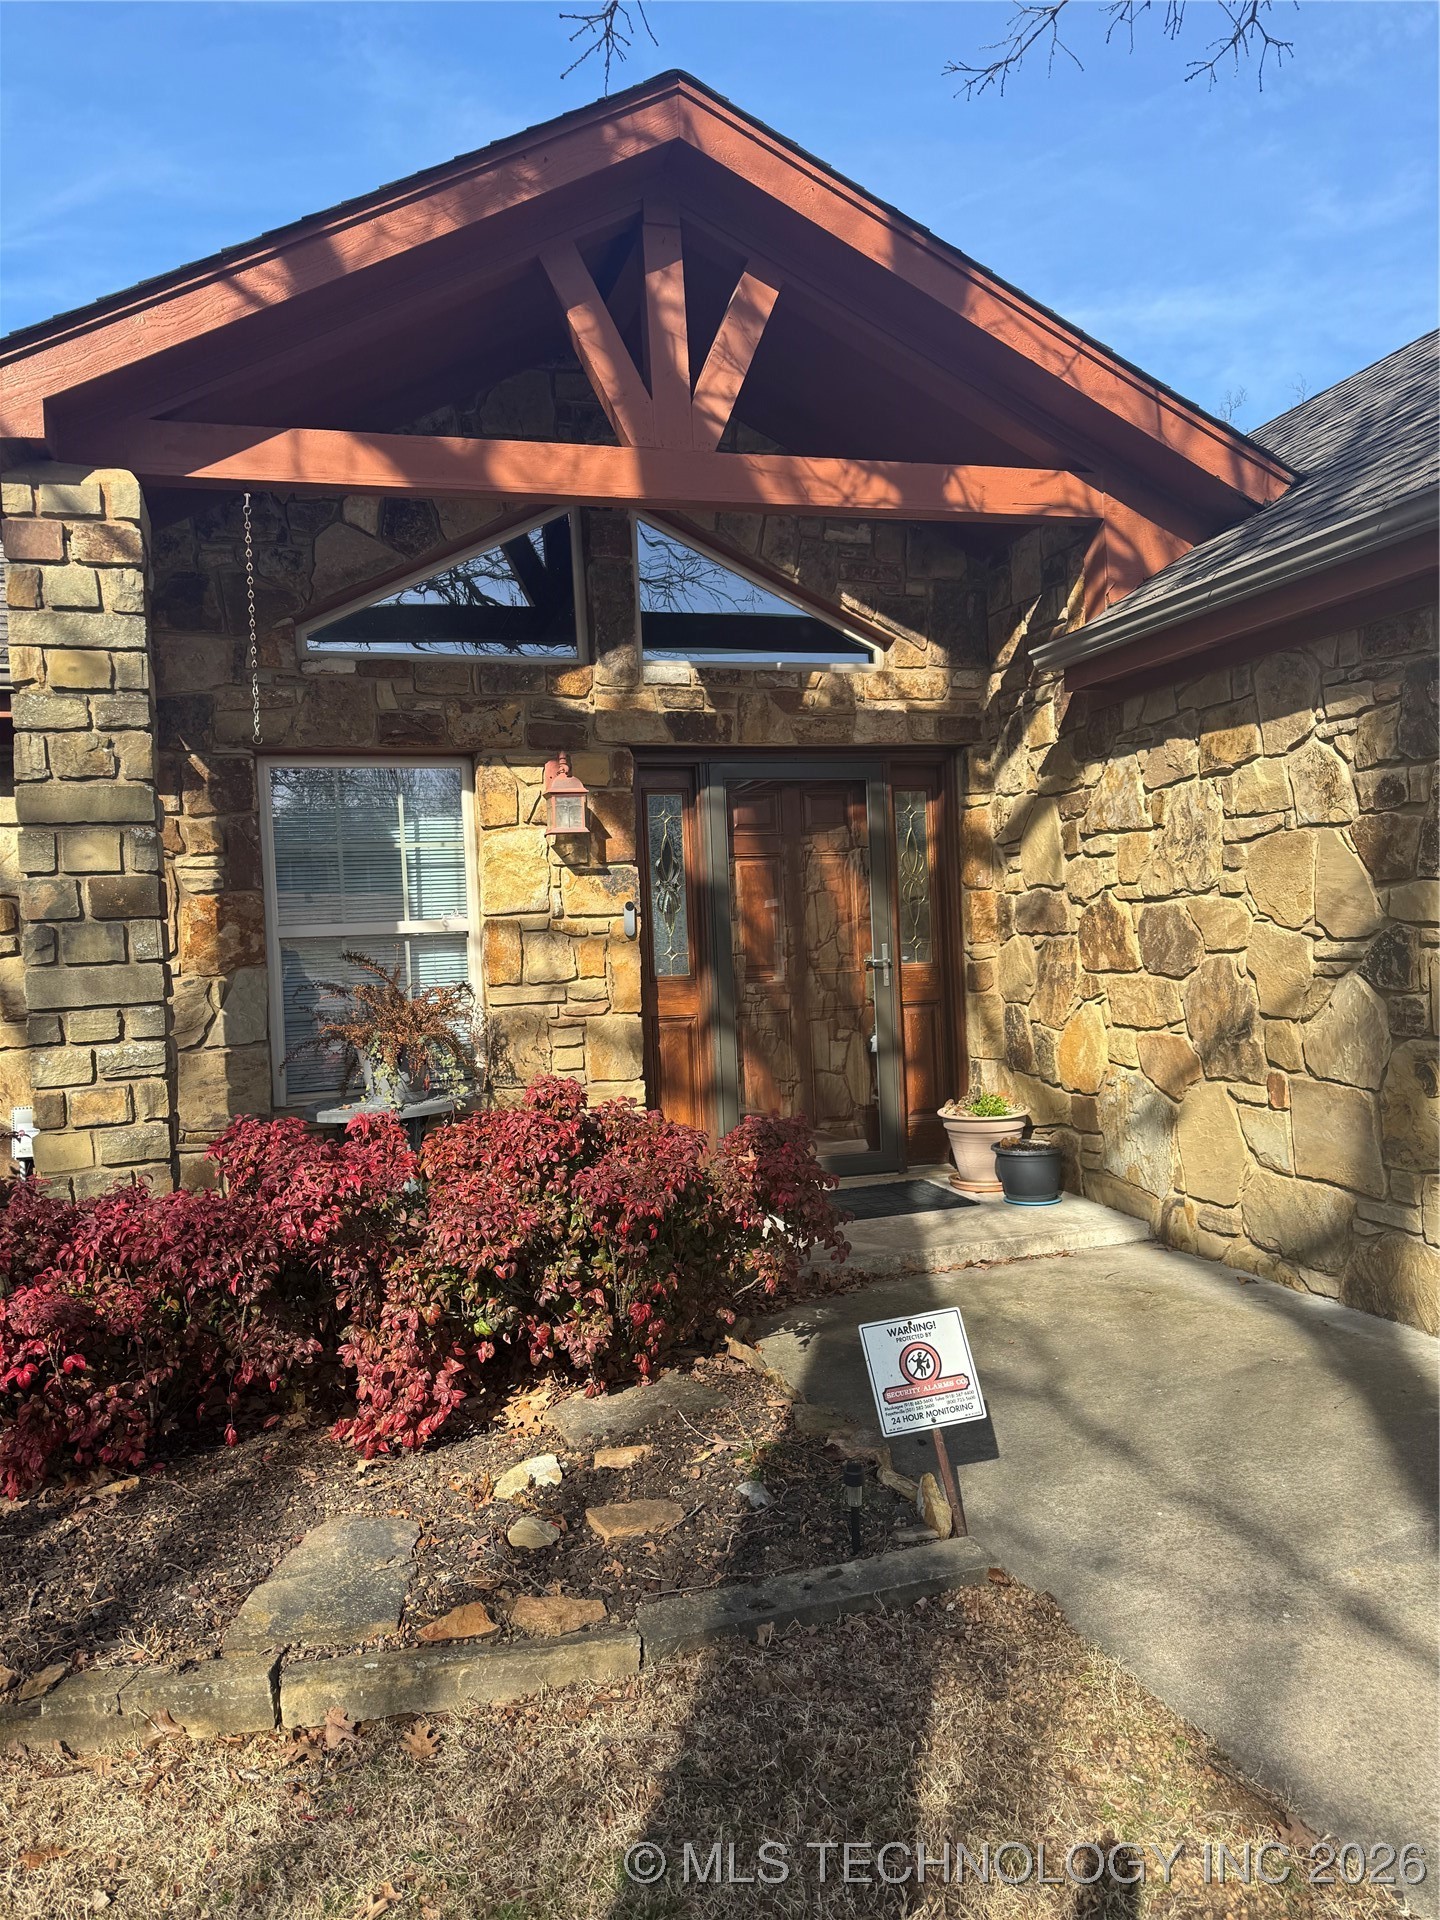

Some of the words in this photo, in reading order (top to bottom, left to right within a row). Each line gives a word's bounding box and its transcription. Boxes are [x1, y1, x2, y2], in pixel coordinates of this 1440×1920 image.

[886, 1320, 936, 1337] WARNING!
[896, 1333, 924, 1342] PROTECTED
[886, 1387, 920, 1399] SECURITY
[923, 1381, 954, 1392] ALARMS
[891, 1416, 901, 1425] 24
[902, 1412, 924, 1423] HOUR
[926, 1402, 974, 1418] MONITORING
